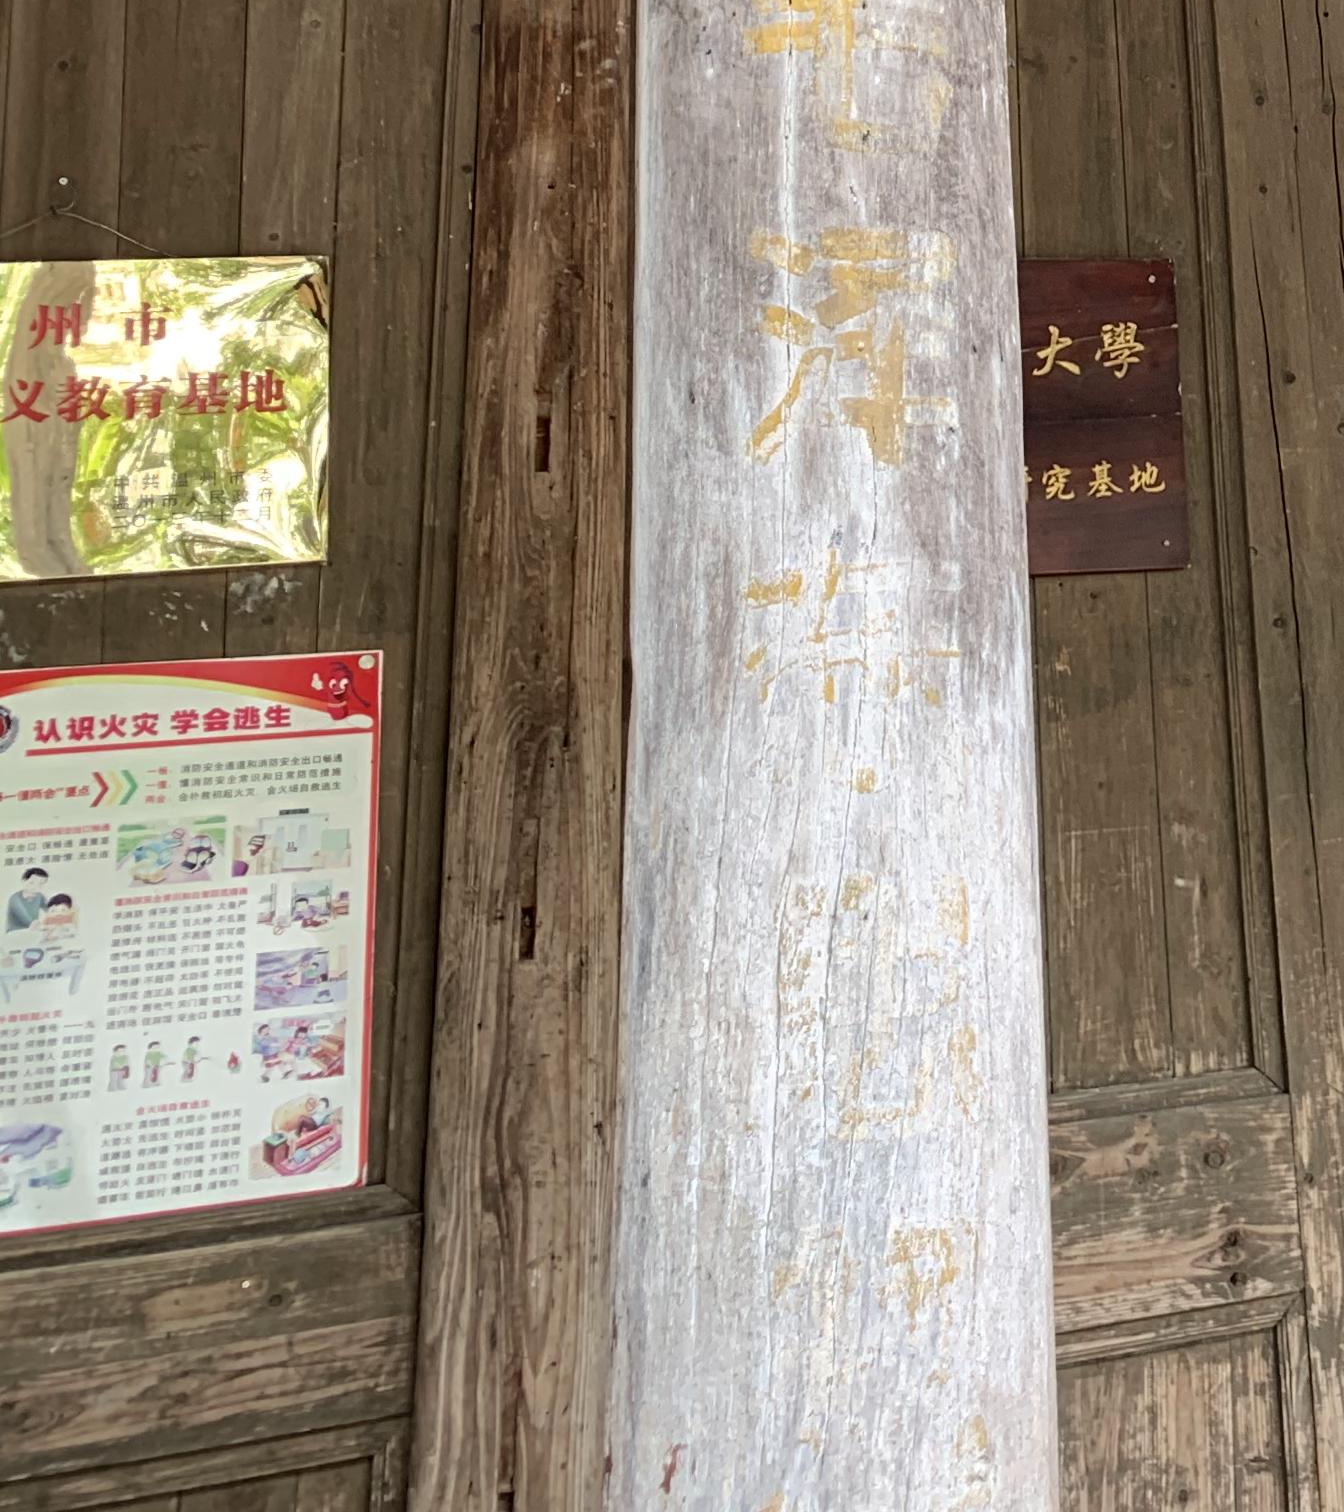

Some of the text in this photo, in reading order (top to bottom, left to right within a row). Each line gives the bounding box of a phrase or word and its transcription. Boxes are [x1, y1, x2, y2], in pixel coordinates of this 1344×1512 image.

[1032, 320, 1145, 379] 大學
[0, 368, 289, 424] 义教育基地
[1025, 459, 1166, 504] 究基地
[33, 704, 292, 744] 认识火灾 学会逃生
